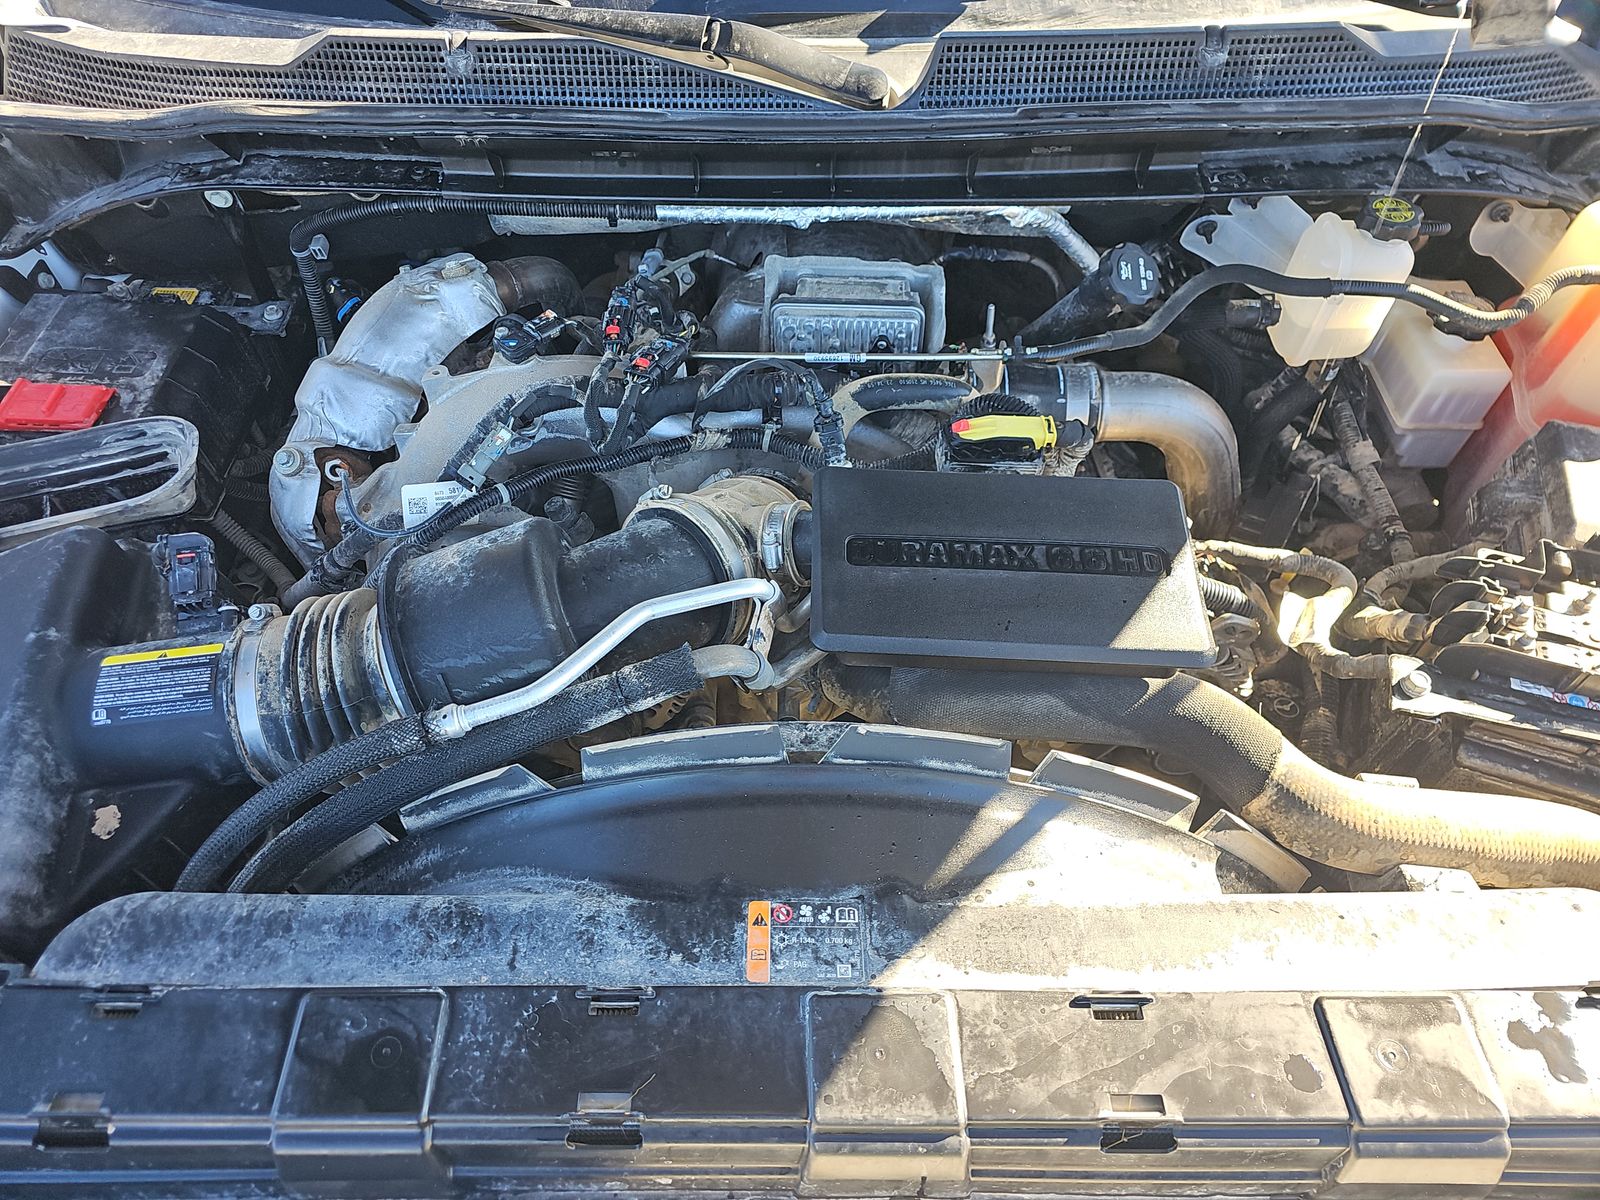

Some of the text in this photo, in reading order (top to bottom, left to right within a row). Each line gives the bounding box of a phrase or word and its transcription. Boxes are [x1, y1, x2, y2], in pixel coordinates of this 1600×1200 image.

[850, 354, 861, 362] GM
[1117, 548, 1164, 573] HD
[844, 937, 853, 946] kg
